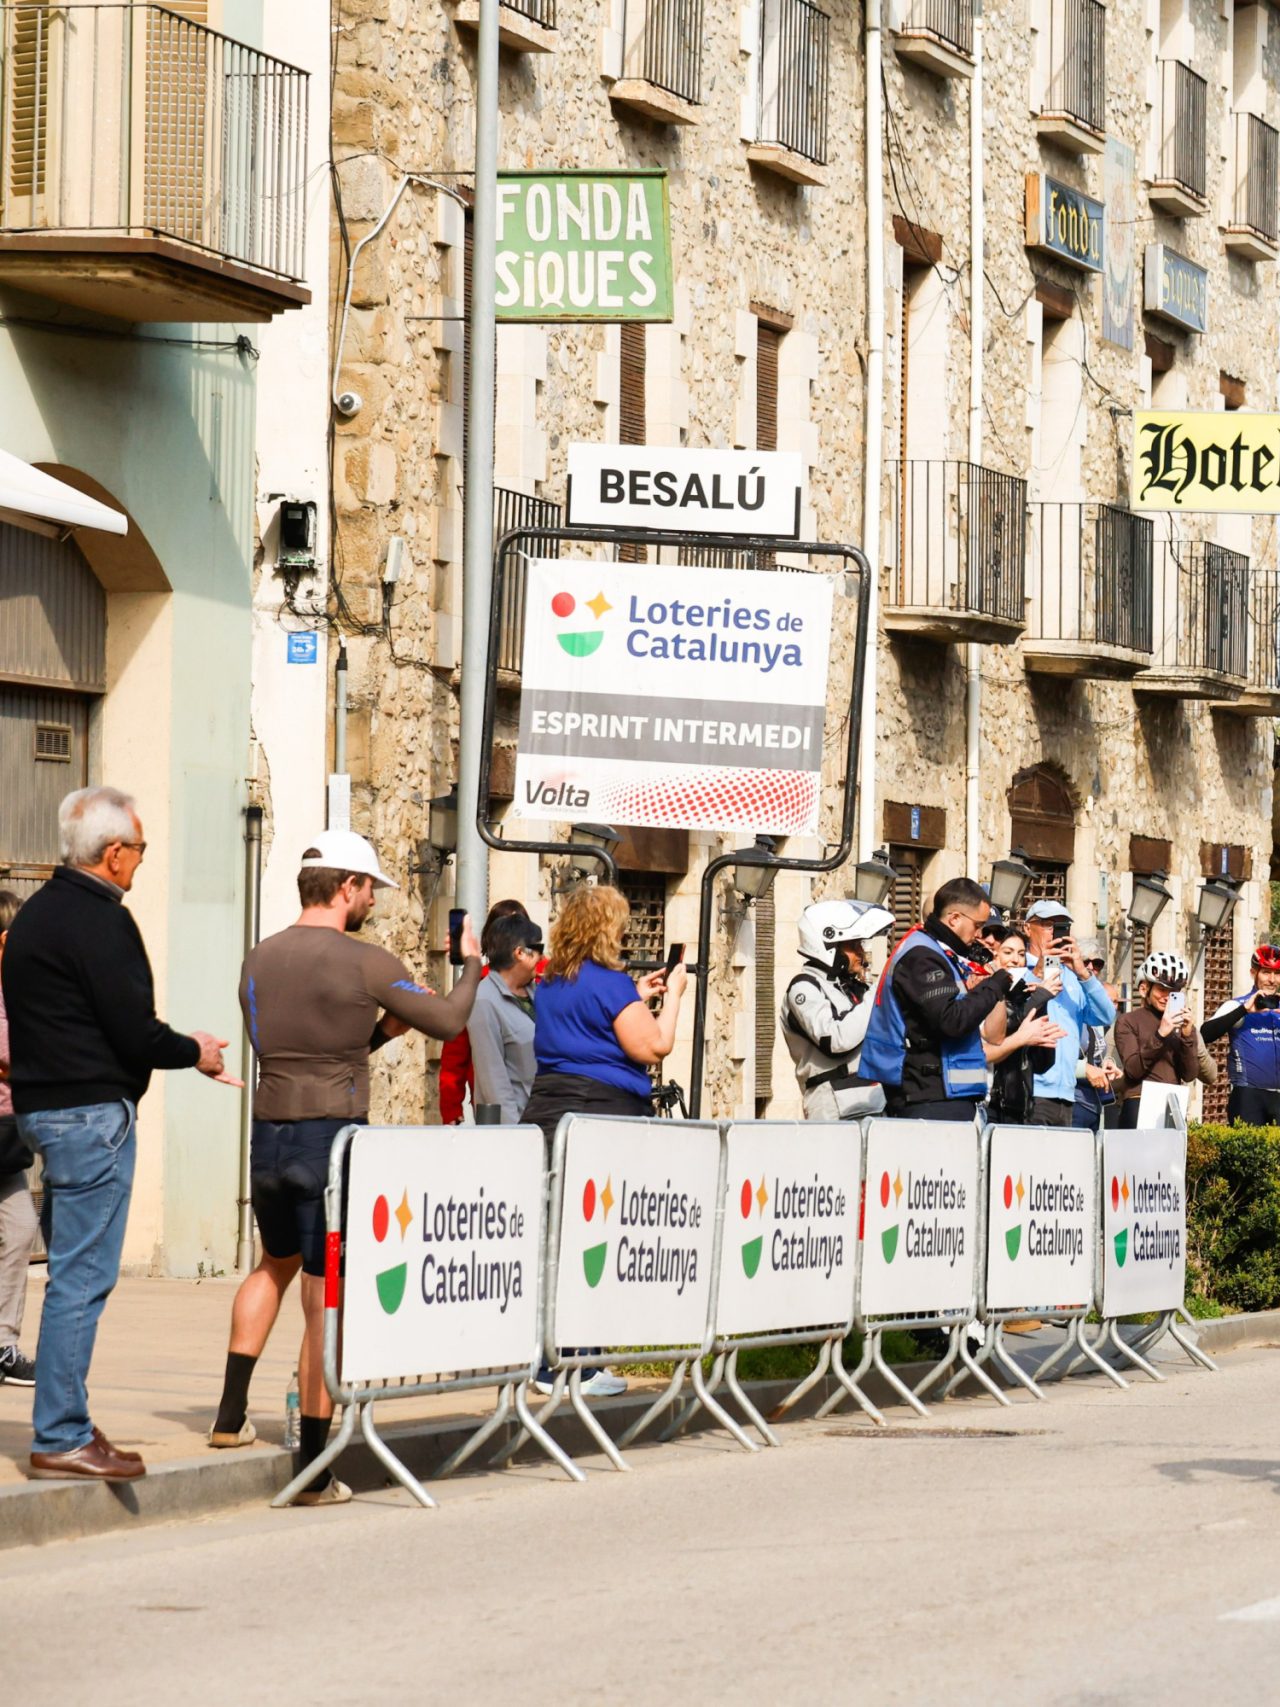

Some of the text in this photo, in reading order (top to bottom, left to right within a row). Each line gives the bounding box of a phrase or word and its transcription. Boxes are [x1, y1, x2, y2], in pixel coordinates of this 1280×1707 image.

[496, 183, 653, 241] FONDA
[599, 466, 766, 511] BESALÚ
[628, 595, 803, 633] Loteries de
[626, 629, 803, 673] Catalunya
[530, 710, 811, 750] ESPRINT INTERMEDI
[526, 779, 590, 807] Volta
[620, 1179, 702, 1228] Loteries de
[773, 1173, 845, 1219] Loteries de
[907, 1168, 966, 1211] Loteries de
[1029, 1173, 1084, 1212] Loteries de
[1132, 1172, 1180, 1213] Loteries de
[422, 1187, 524, 1242] Loteries de
[771, 1226, 843, 1279] Catalunya
[905, 1217, 965, 1267] Catalunya
[1028, 1219, 1083, 1266] Catalunya
[1132, 1221, 1180, 1270] Catalunya
[421, 1250, 522, 1314] Catalunya
[616, 1236, 698, 1296] Catalunya
